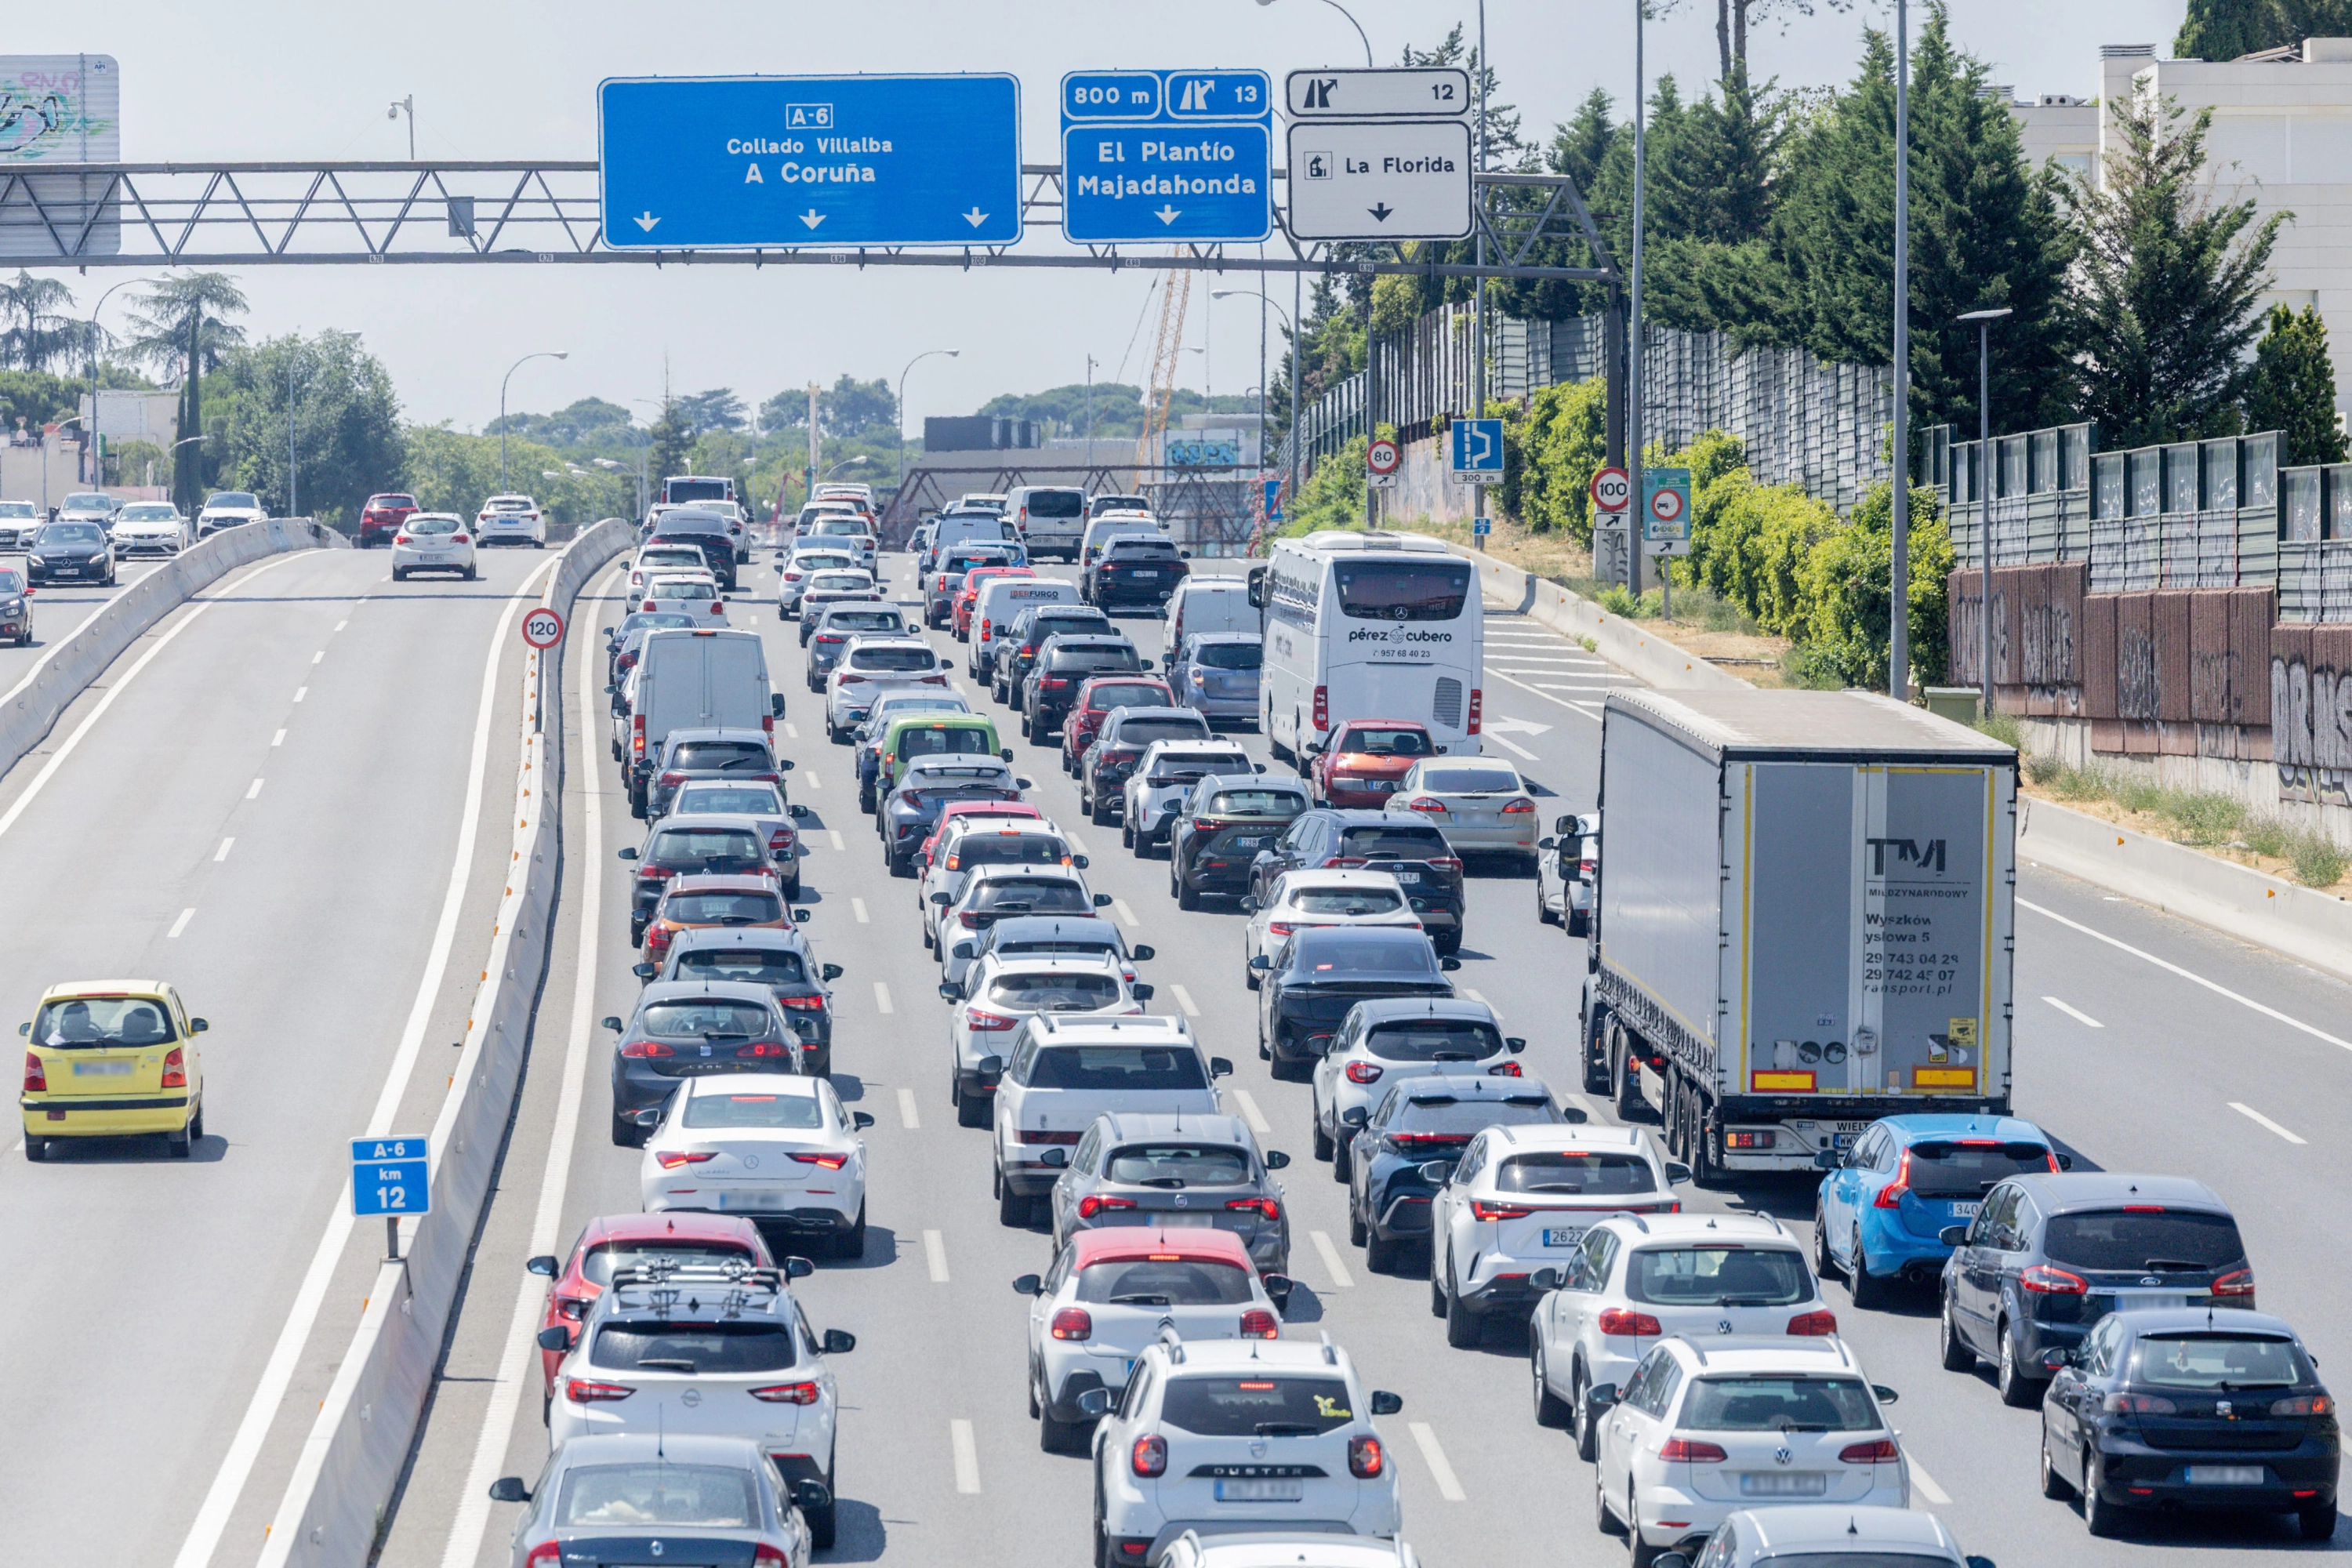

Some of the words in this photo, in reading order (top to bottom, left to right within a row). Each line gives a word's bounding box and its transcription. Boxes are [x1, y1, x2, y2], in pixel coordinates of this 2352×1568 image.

[1074, 86, 1120, 104] 800
[1131, 91, 1149, 103] m
[1235, 85, 1258, 103] 13
[1432, 84, 1454, 100] 12
[792, 108, 829, 125] A-6
[727, 137, 804, 154] Collado
[817, 136, 893, 154] Villalba
[1098, 142, 1124, 162] El
[1142, 140, 1235, 162] Plantío
[745, 163, 764, 183] A
[782, 162, 876, 183] Coruña
[1346, 158, 1370, 174] La
[1383, 157, 1455, 173] Florida
[1078, 174, 1256, 199] Majadahonda
[1374, 451, 1392, 462] 80
[1599, 482, 1628, 496] 100
[528, 621, 557, 636] 120
[1348, 627, 1388, 642] pérez
[1406, 630, 1452, 642] cubero
[1922, 932, 1930, 942] 5
[1865, 953, 1883, 964] 29
[1888, 953, 1914, 964] 743
[1918, 953, 1936, 965] 04
[1865, 968, 1882, 980] 29
[1886, 969, 1913, 981] 742
[1938, 970, 1956, 982] 07
[373, 1142, 405, 1158] A-6
[379, 1167, 402, 1181] km
[376, 1185, 406, 1209] 12
[1552, 1231, 1583, 1243] 2622
[1214, 1467, 1302, 1475] DUSTER
